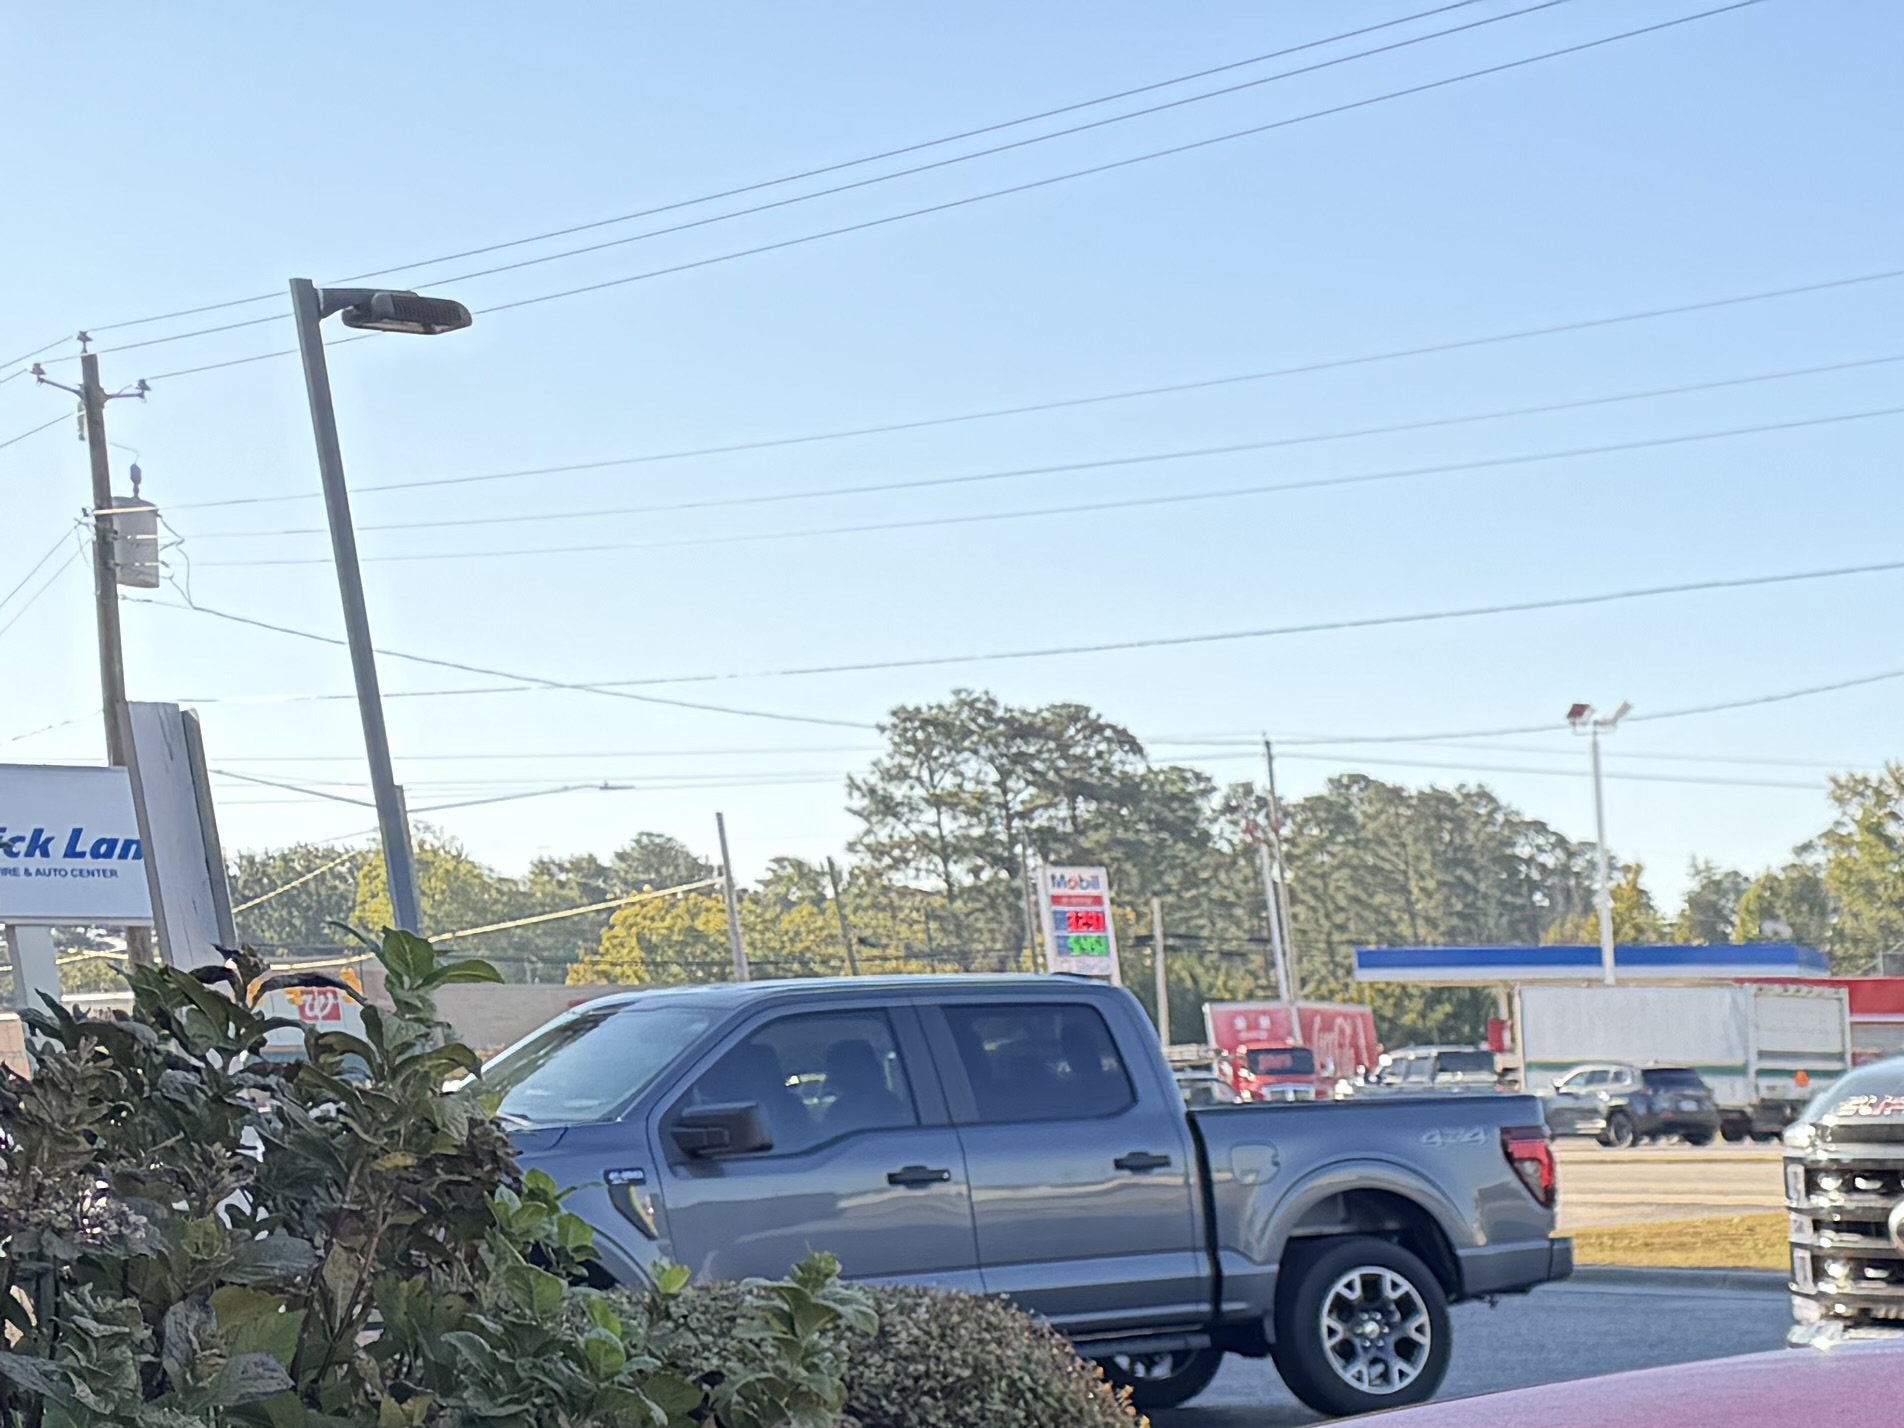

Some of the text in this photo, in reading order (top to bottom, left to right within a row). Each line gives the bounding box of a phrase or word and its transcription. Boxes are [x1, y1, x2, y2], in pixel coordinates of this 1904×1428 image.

[63, 827, 144, 860] Lan
[35, 867, 68, 877] AUTO
[70, 868, 118, 878] CENTER
[1051, 874, 1100, 890] Mobil
